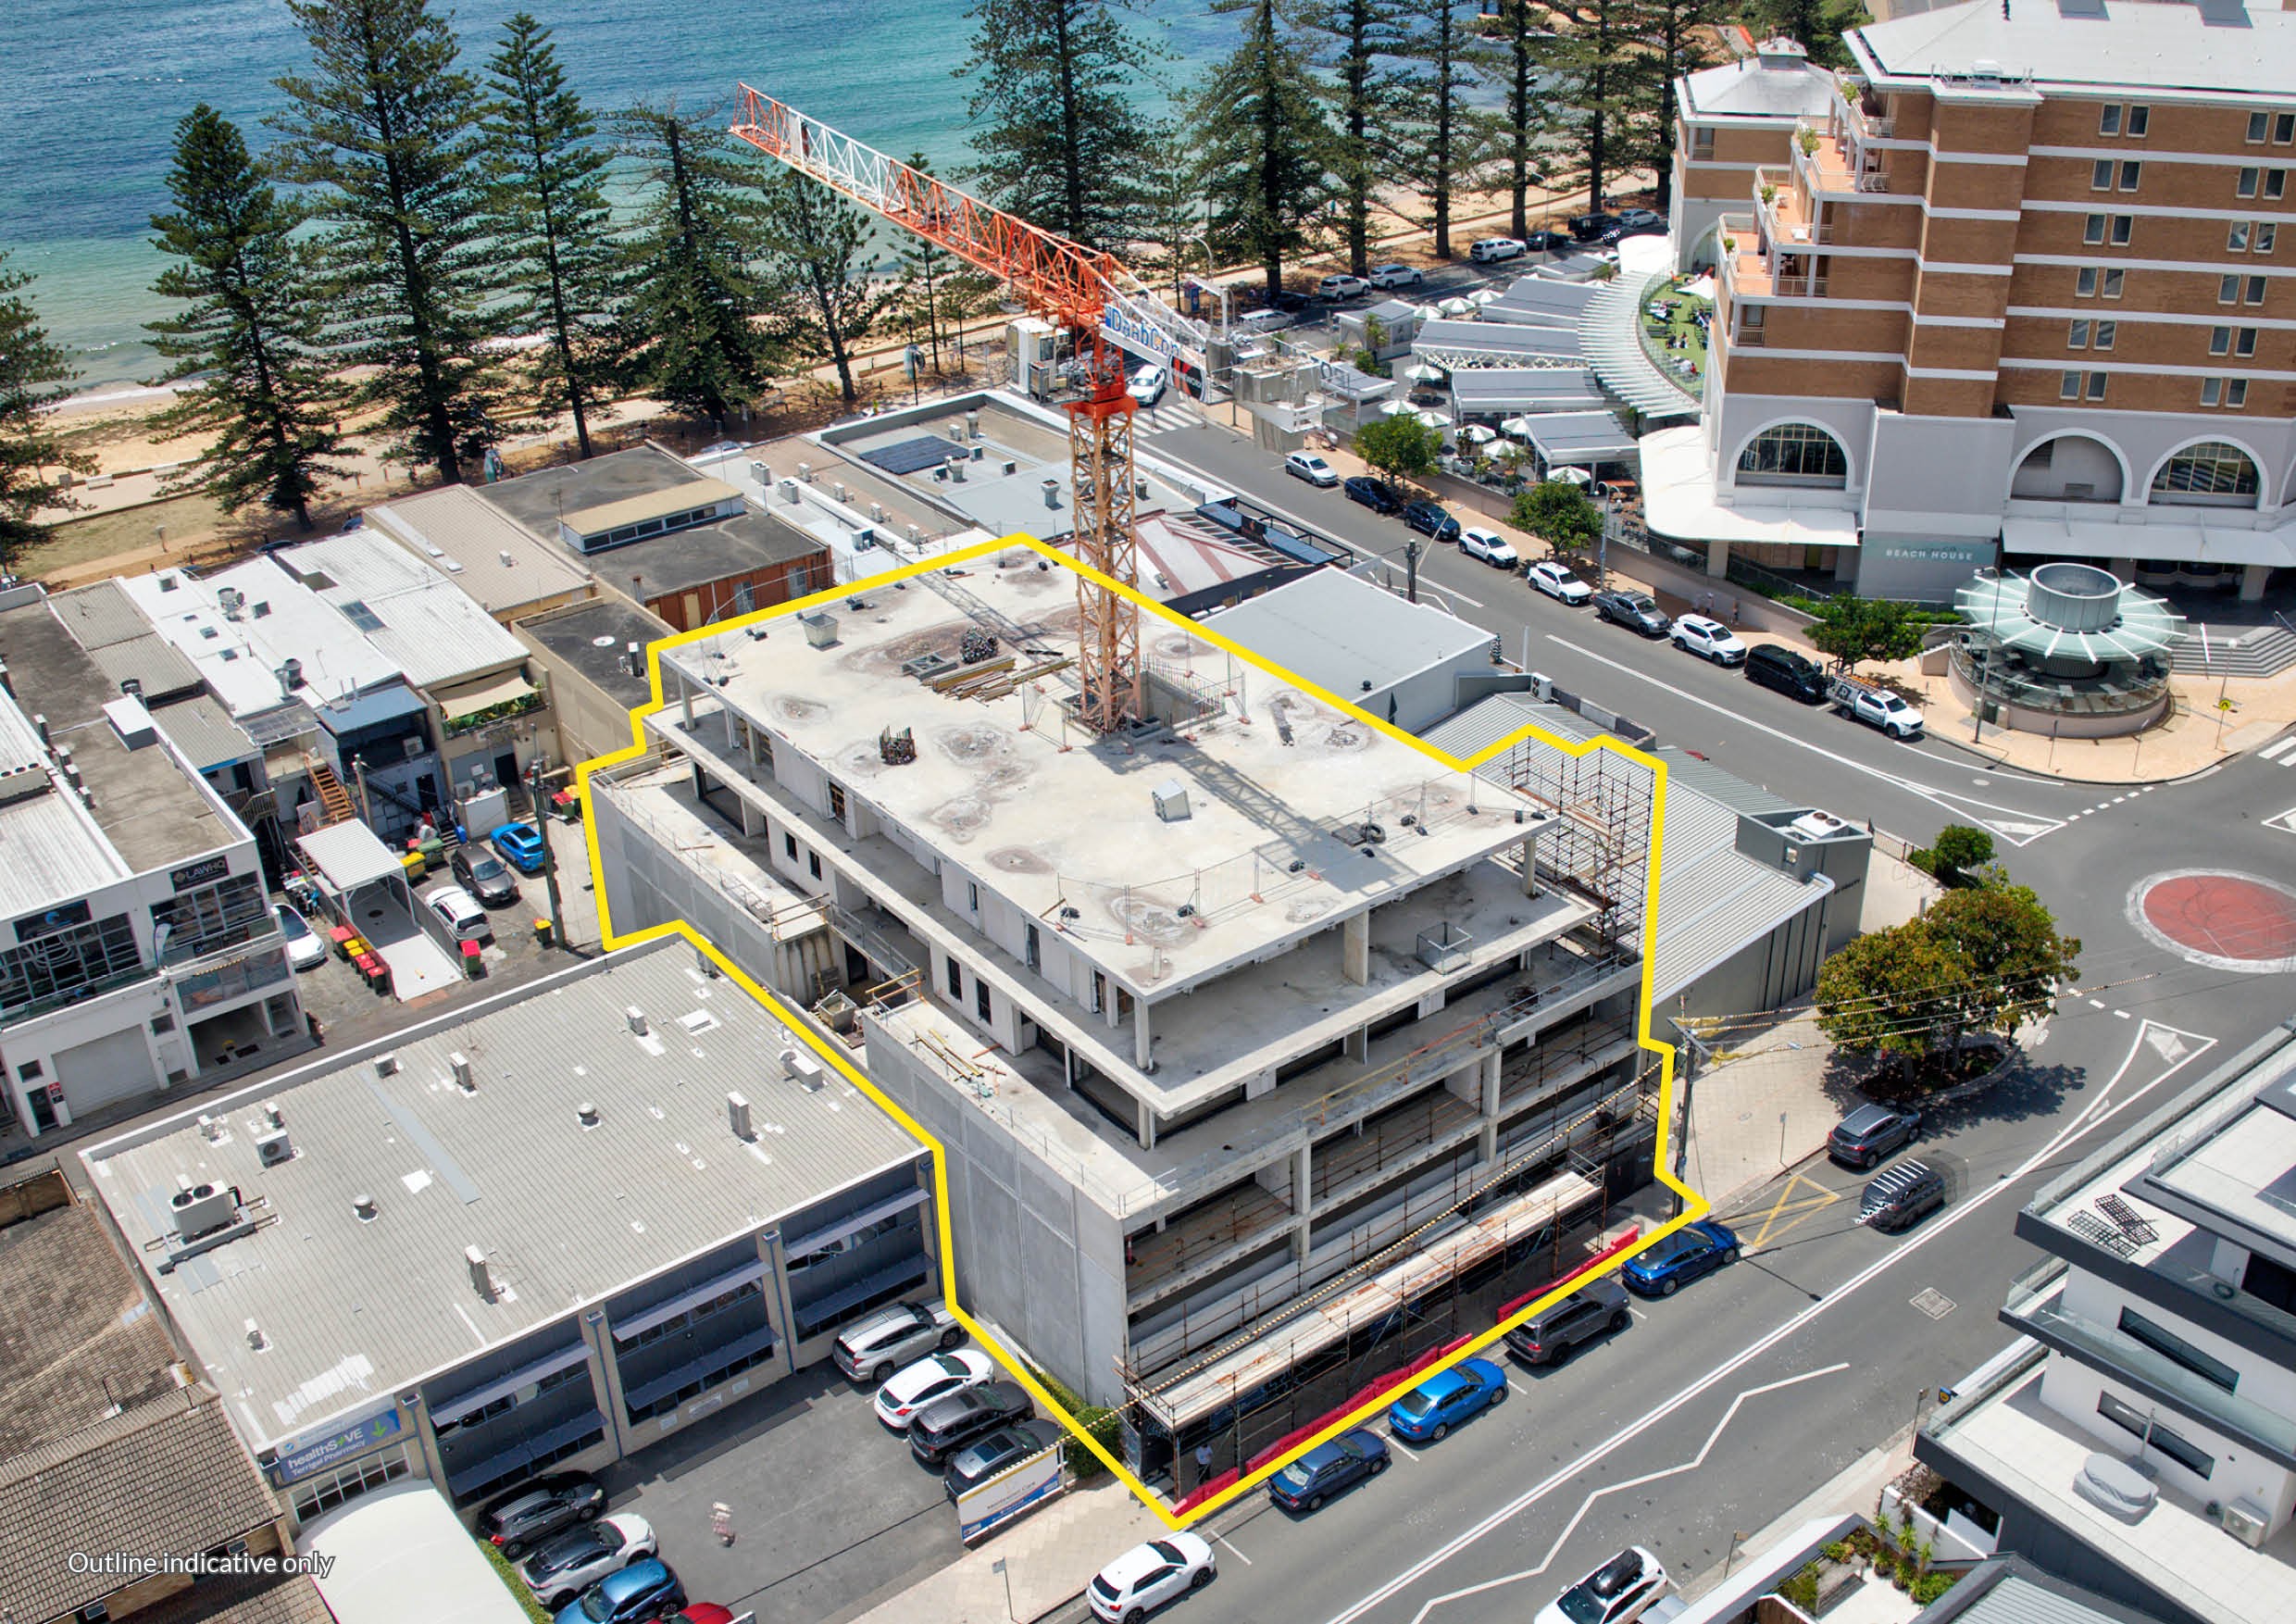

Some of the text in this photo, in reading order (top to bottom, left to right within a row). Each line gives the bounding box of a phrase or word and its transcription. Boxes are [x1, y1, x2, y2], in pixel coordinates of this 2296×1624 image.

[1886, 548, 1974, 561] BEACH HOUSE
[324, 1439, 366, 1462] Pharmacy
